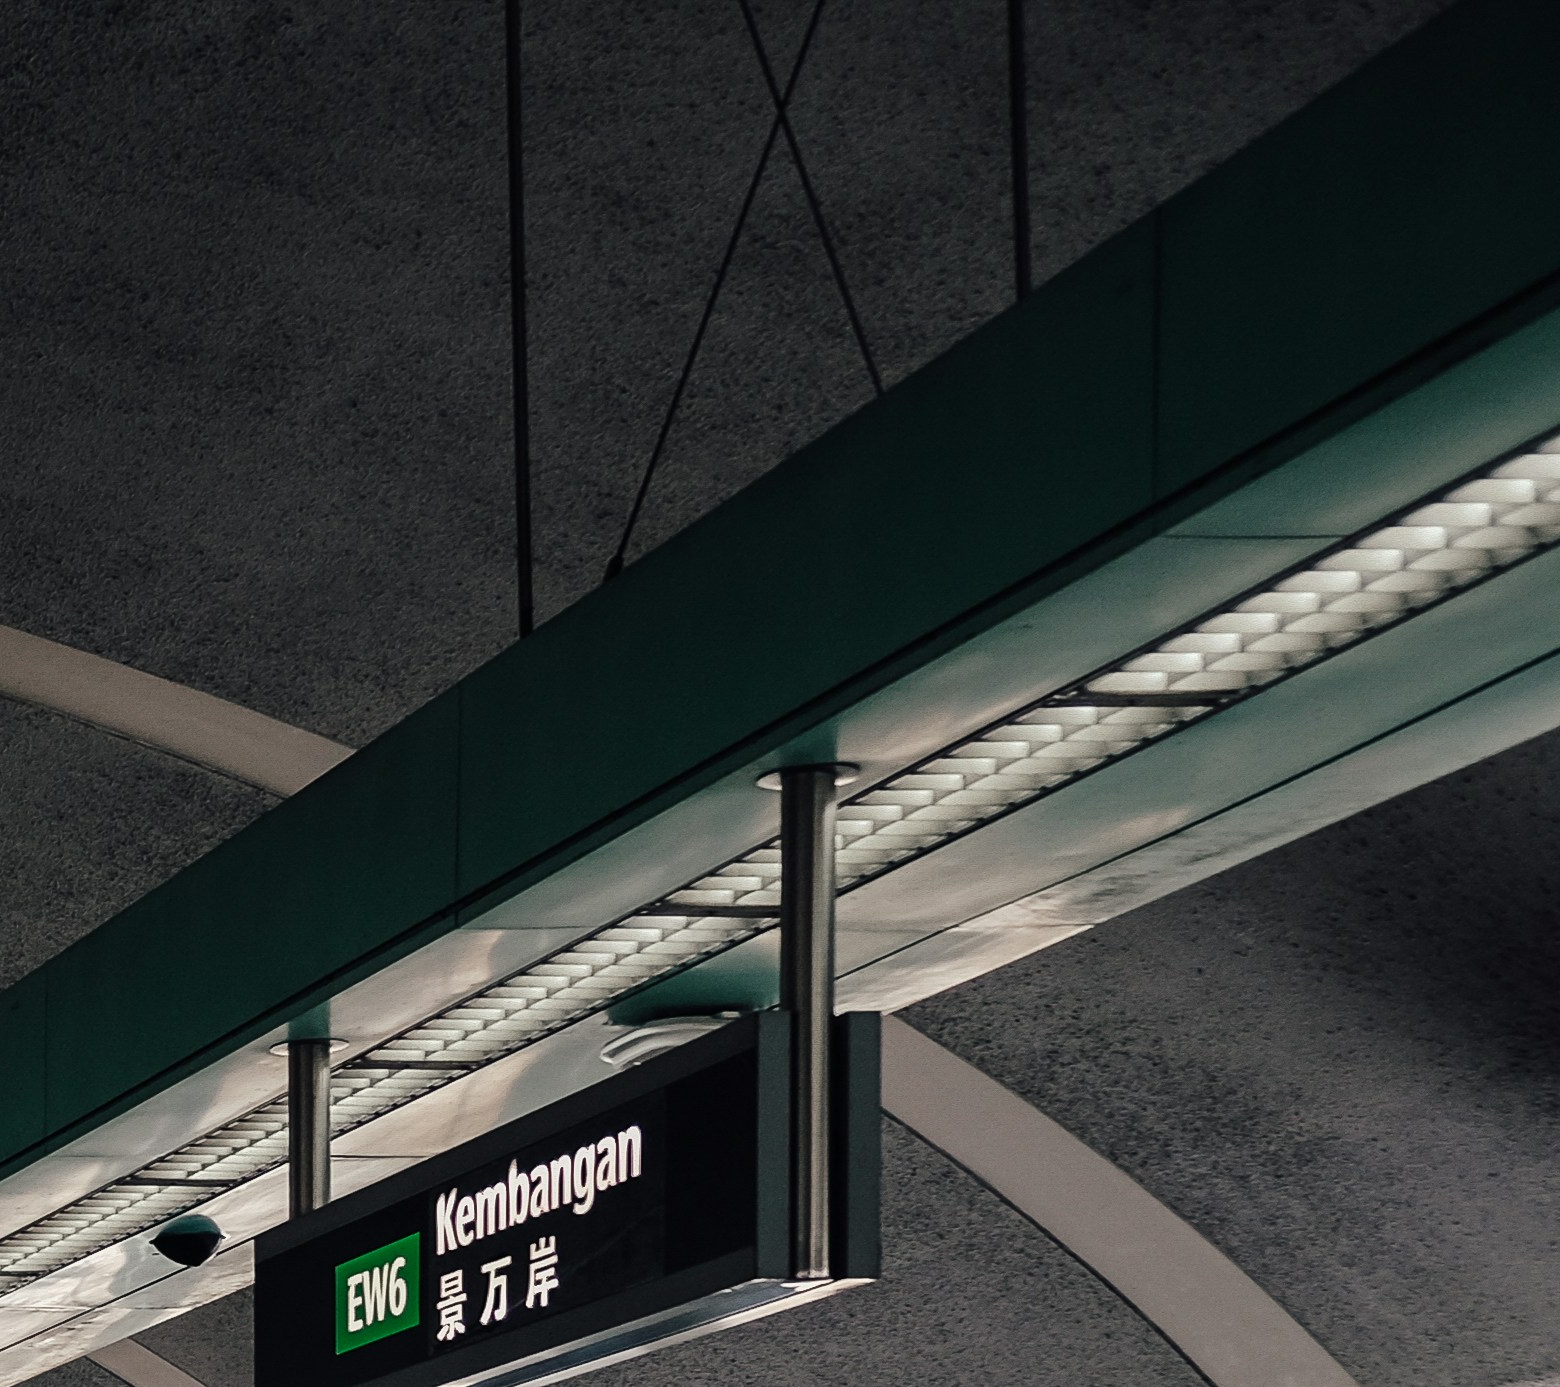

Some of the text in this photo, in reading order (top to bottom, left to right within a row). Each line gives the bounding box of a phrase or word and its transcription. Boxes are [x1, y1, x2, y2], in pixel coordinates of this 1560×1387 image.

[435, 1123, 643, 1256] Kembangan
[346, 1256, 409, 1333] EW6
[435, 1235, 561, 1342] 景万岸
